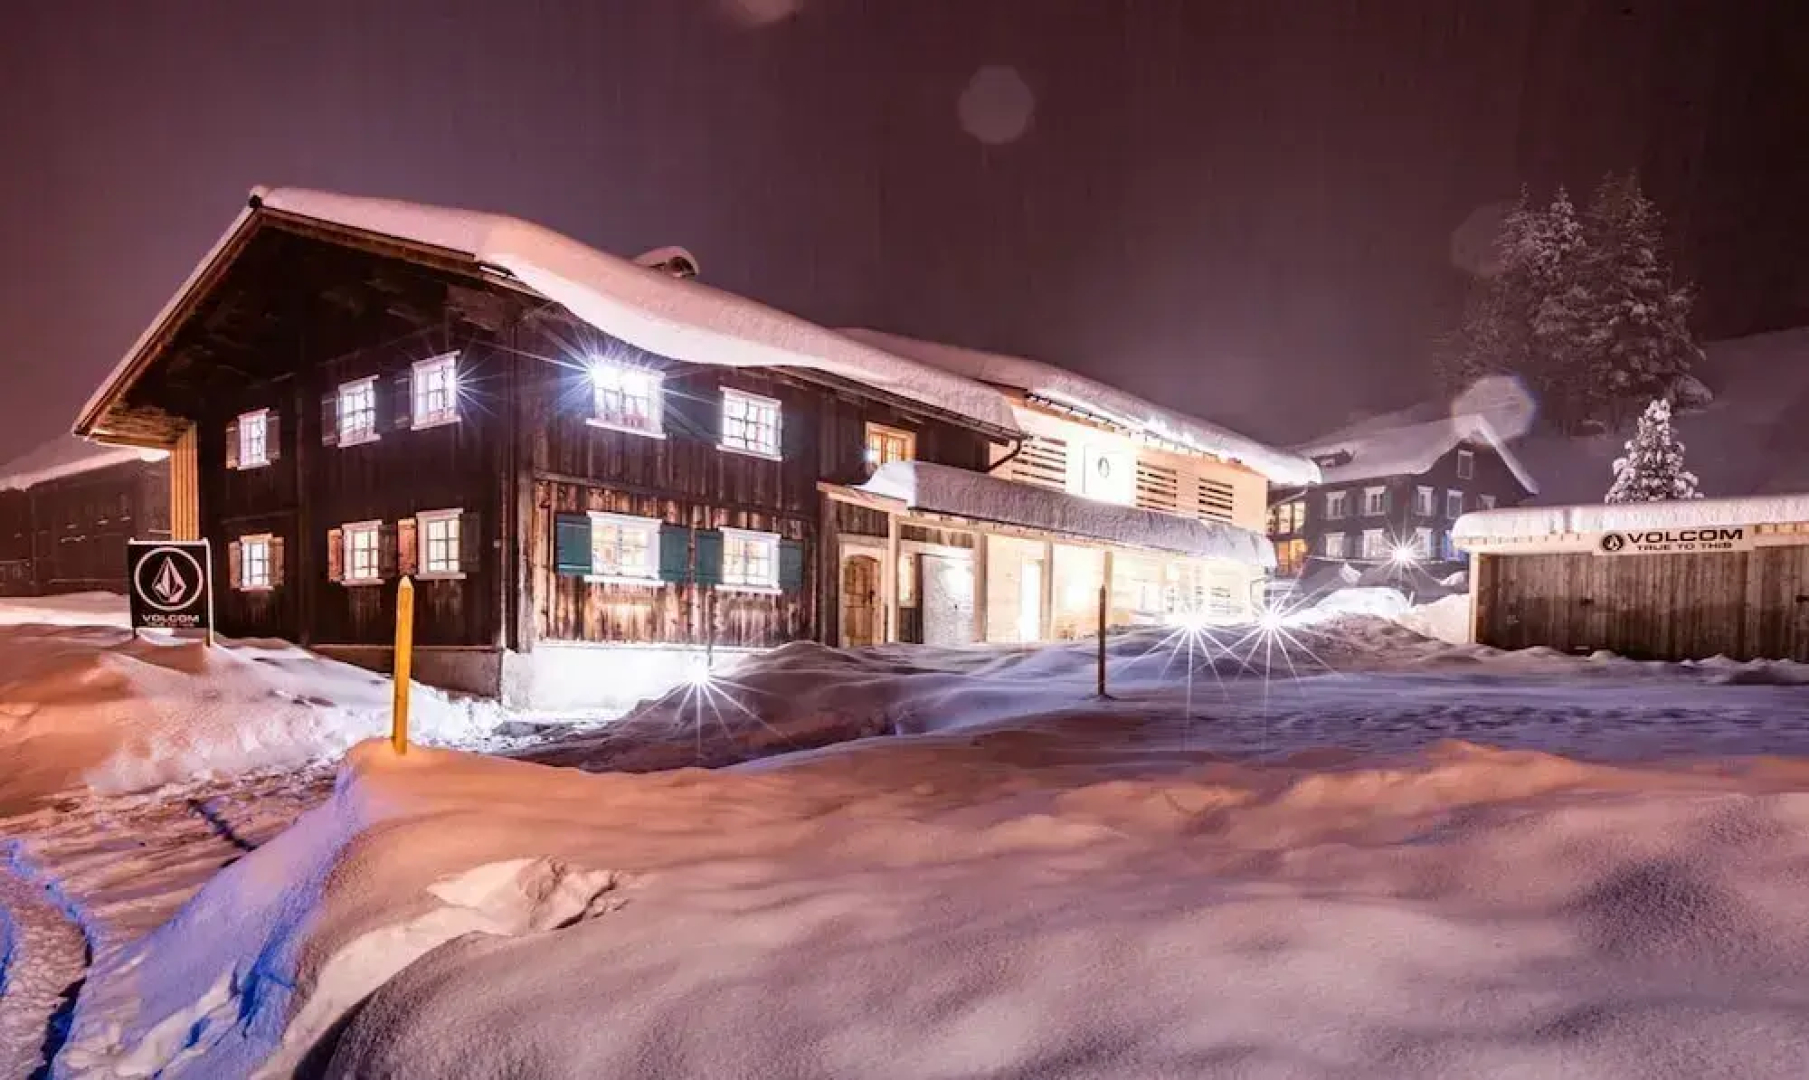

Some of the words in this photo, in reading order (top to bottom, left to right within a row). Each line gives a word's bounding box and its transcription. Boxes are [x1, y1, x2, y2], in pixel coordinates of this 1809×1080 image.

[1627, 529, 1743, 543] VOLCOM
[1678, 543, 1696, 551] TO
[142, 614, 199, 622] VOLCOM
